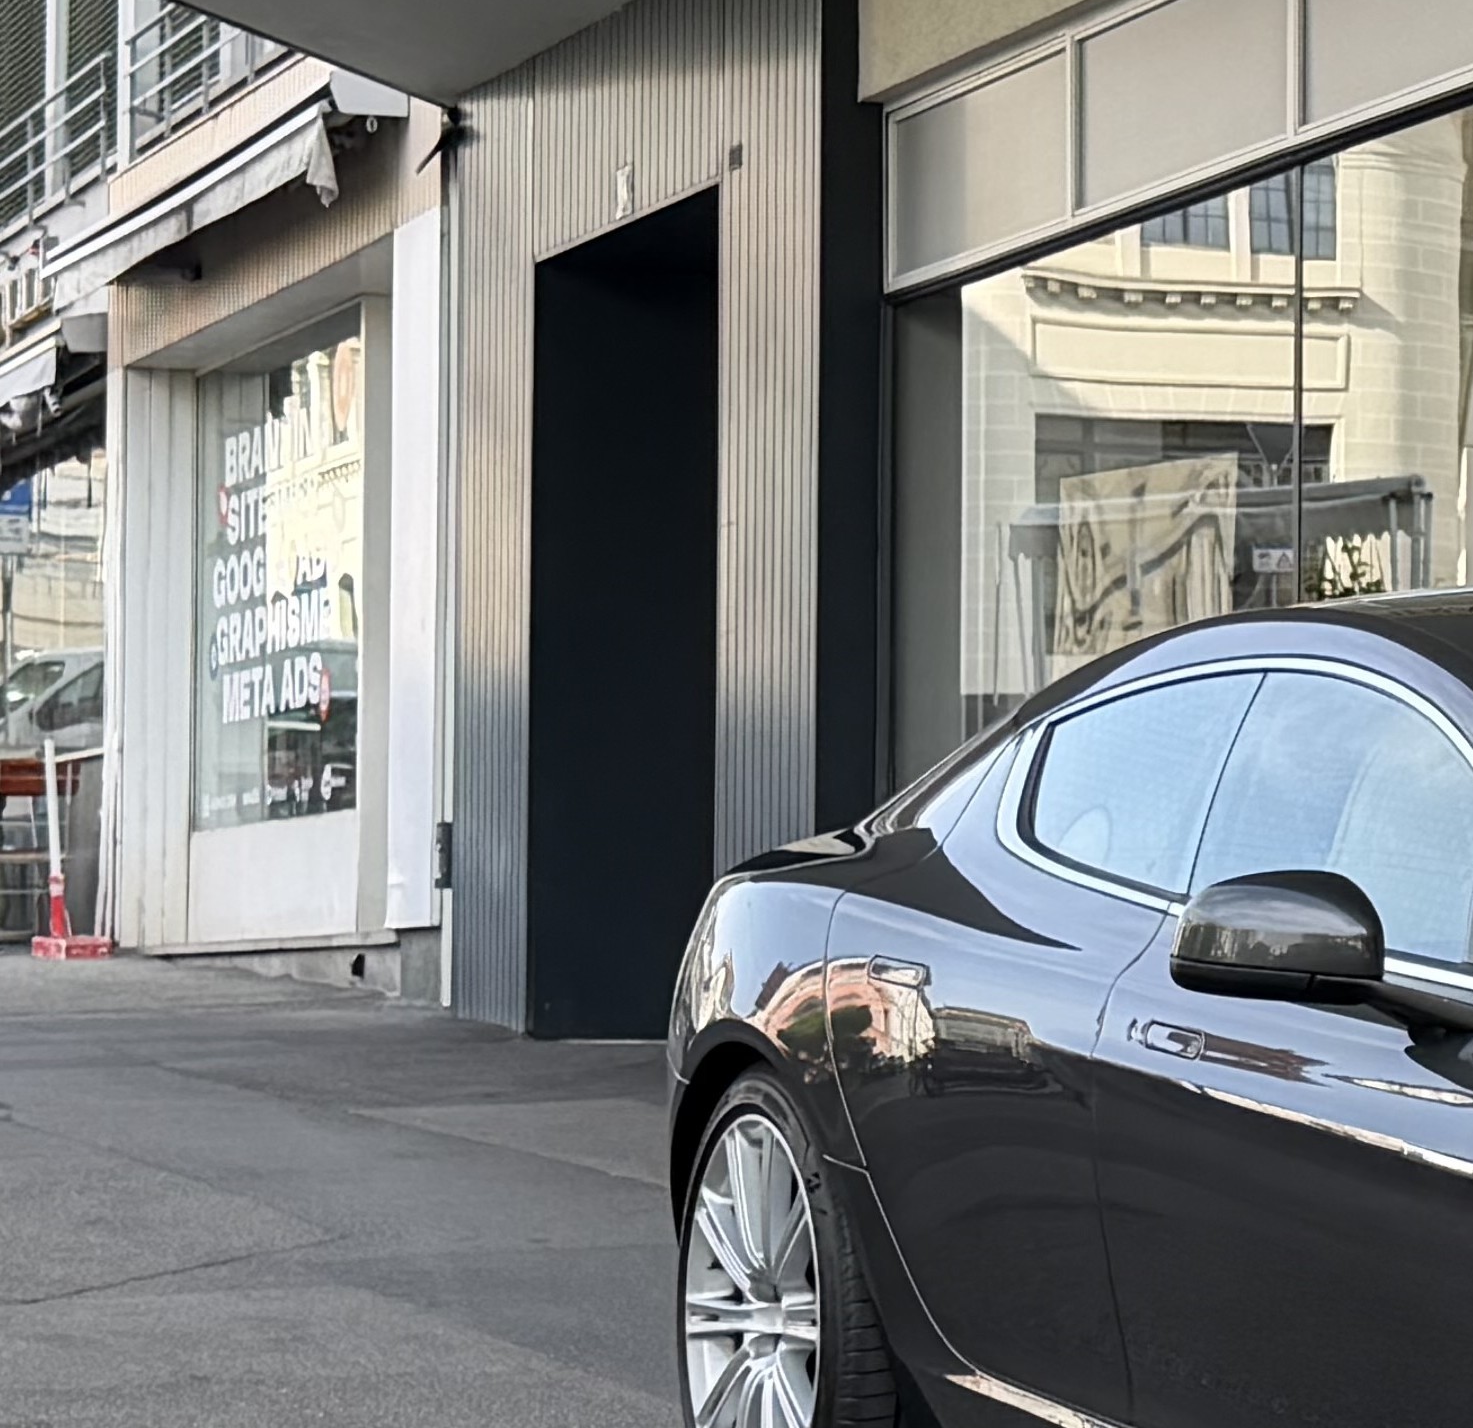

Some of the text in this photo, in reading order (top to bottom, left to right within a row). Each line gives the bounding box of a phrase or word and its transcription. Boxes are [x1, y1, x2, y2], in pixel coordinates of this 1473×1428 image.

[216, 587, 332, 666] GRAPHISME
[222, 651, 323, 724] META ADS
